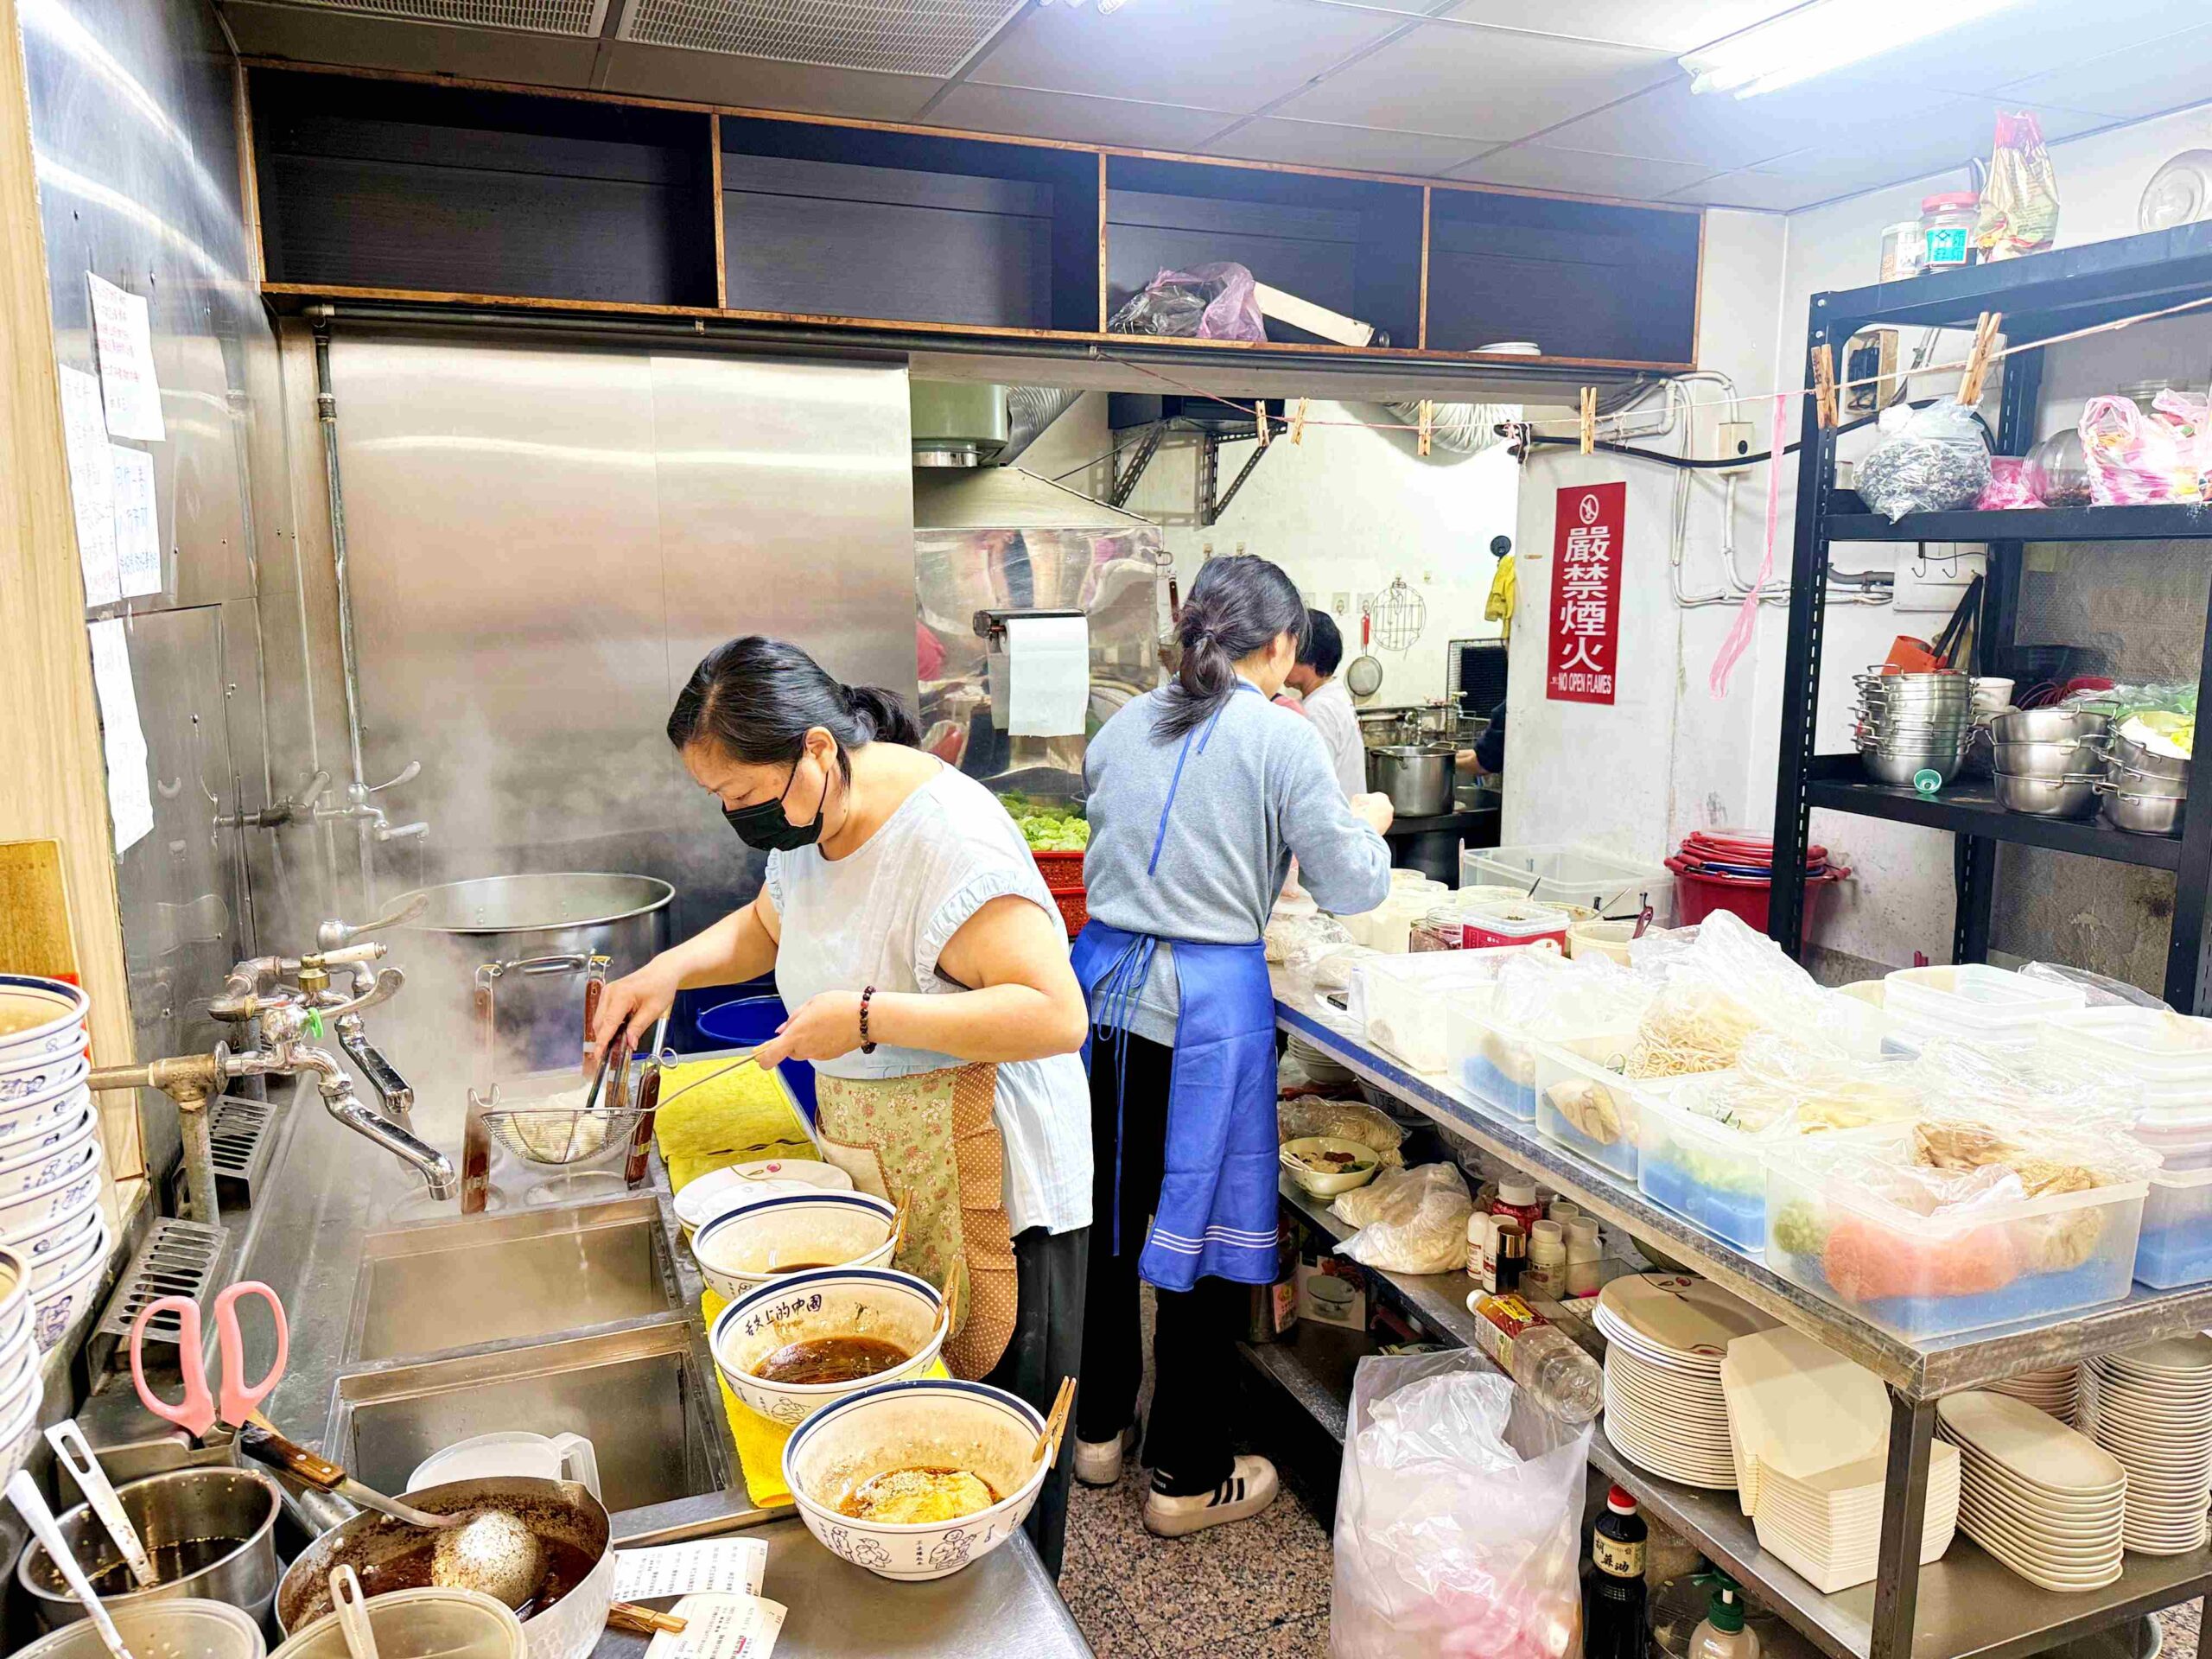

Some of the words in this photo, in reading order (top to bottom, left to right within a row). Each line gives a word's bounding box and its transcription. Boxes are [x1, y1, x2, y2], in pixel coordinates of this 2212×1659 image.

[1560, 525, 1611, 671] 嚴禁煙火
[1558, 672, 1568, 691] NO
[1568, 672, 1586, 693] OPEN
[1586, 674, 1611, 695] FLAMES
